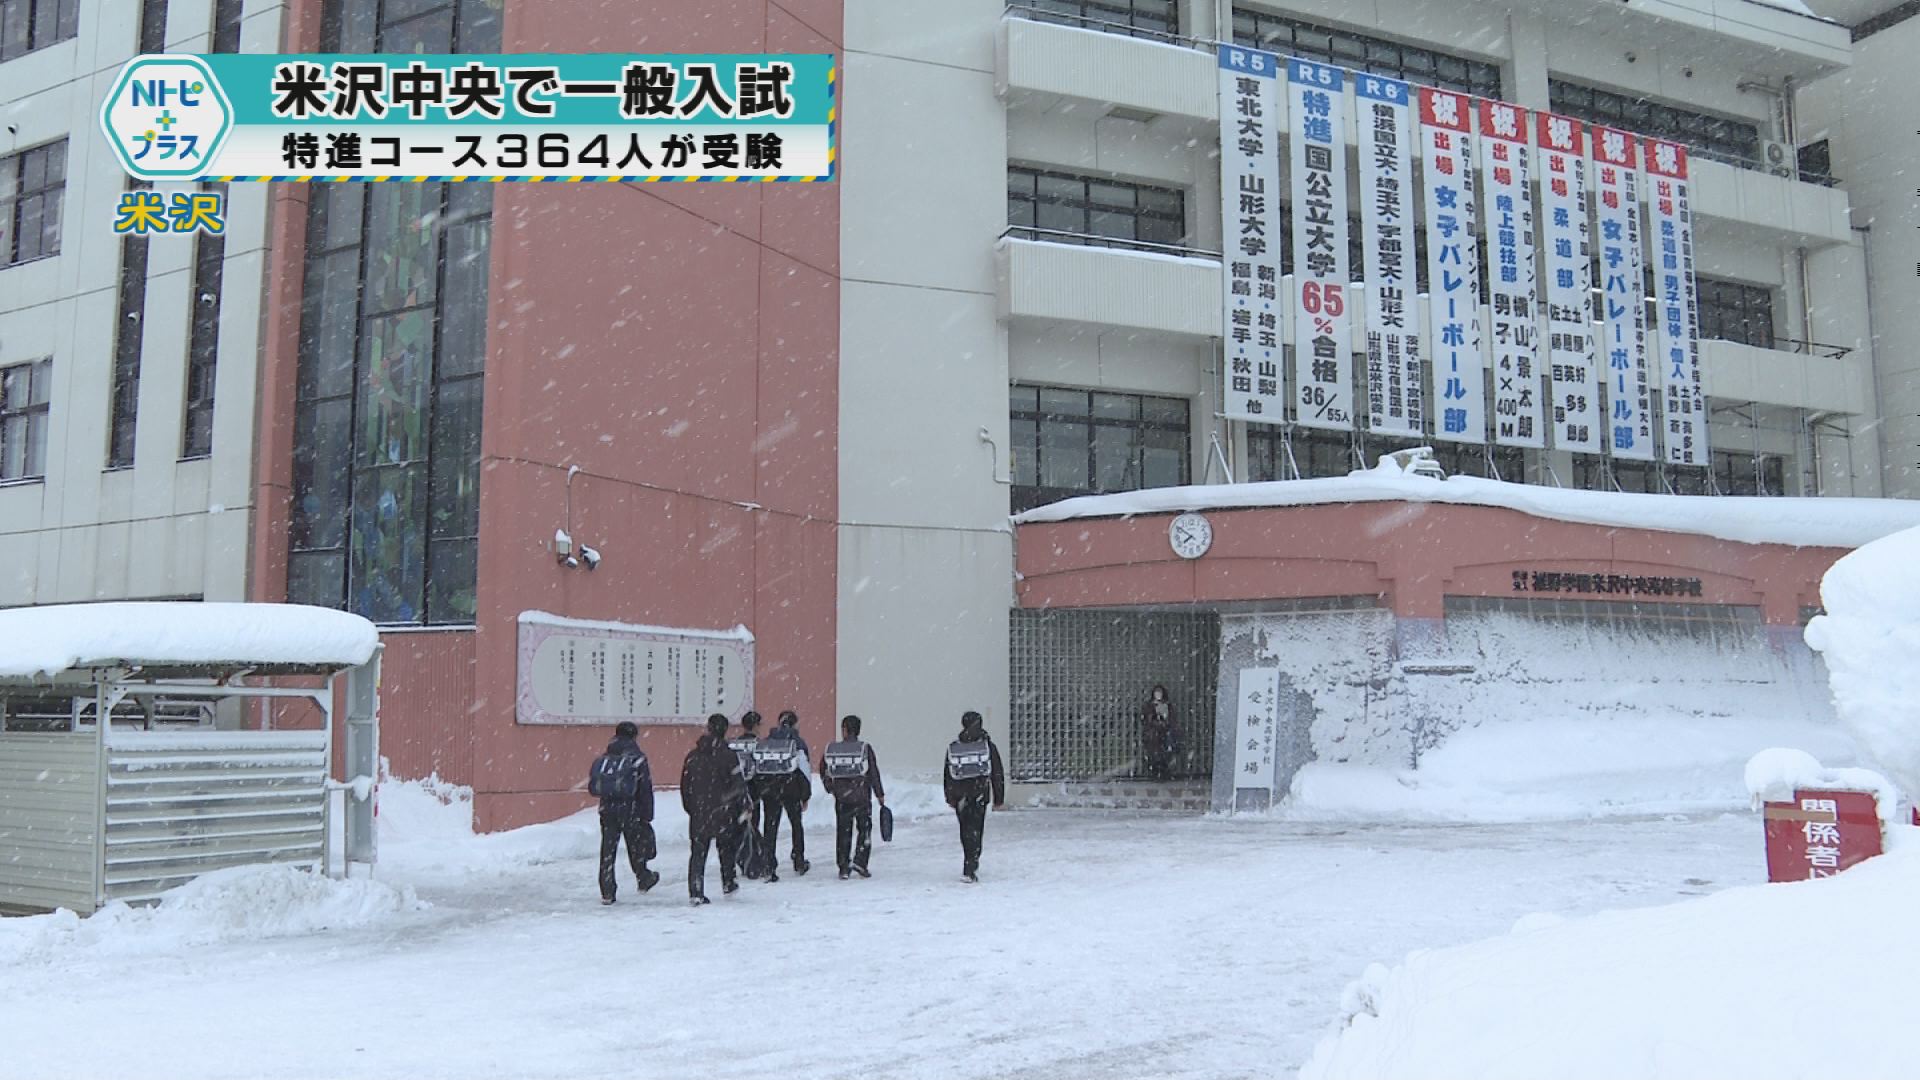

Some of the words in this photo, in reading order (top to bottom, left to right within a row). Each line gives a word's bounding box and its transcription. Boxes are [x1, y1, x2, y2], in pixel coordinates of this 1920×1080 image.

[1230, 50, 1265, 72] R5
[1299, 64, 1333, 85] R5
[1366, 79, 1398, 99] R6
[1235, 76, 1267, 256] 東北大学・山形大学
